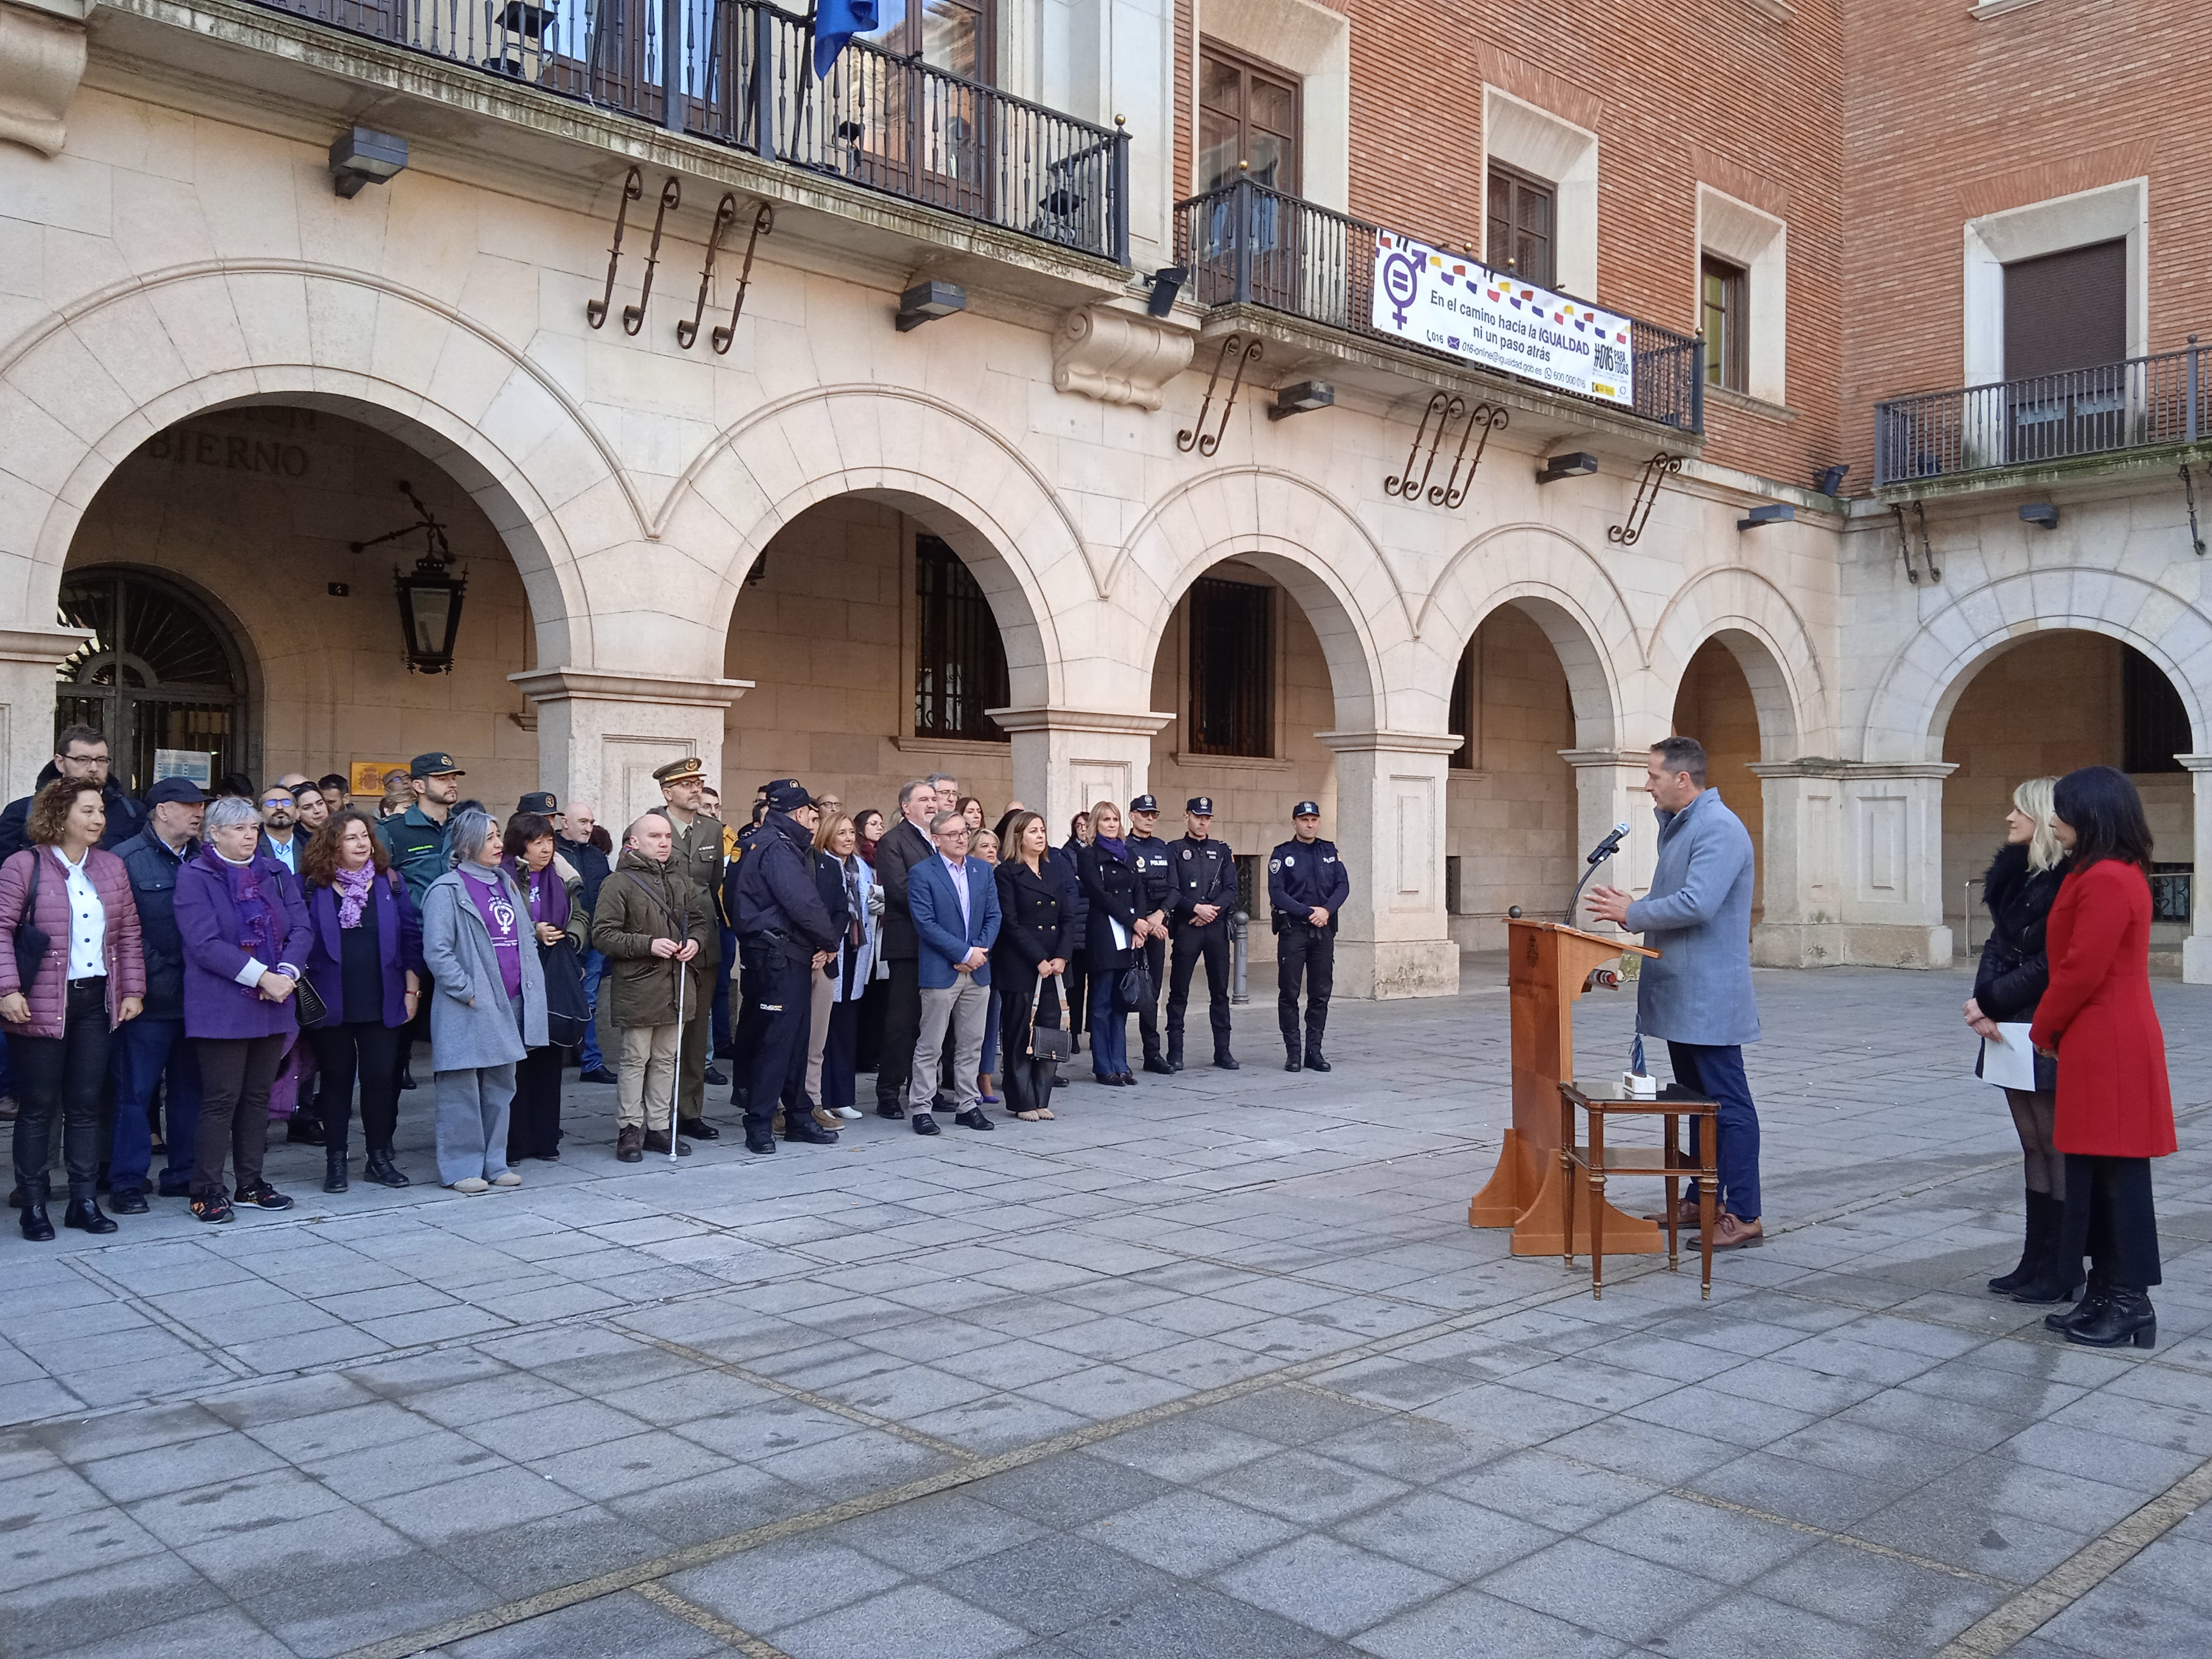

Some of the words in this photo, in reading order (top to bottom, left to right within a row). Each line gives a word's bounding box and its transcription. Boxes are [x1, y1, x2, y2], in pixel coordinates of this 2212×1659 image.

[1430, 290, 1444, 307] En
[1447, 298, 1457, 312] el
[1460, 304, 1495, 325] camino
[1498, 315, 1526, 336] hacia
[1528, 324, 1536, 339] la
[1538, 328, 1590, 356] IGUALDAD
[1431, 332, 1444, 344] 016
[1462, 342, 1542, 375] 016-online@igualdad.gob.es
[1553, 371, 1564, 382] 600
[1565, 374, 1576, 385] 000
[1577, 376, 1586, 388] 016
[1473, 325, 1482, 339] ni
[1486, 331, 1498, 345] un
[1500, 337, 1524, 353] paso
[1527, 345, 1551, 362] atrás
[1594, 342, 1614, 372] #016
[1614, 349, 1626, 363] PARA
